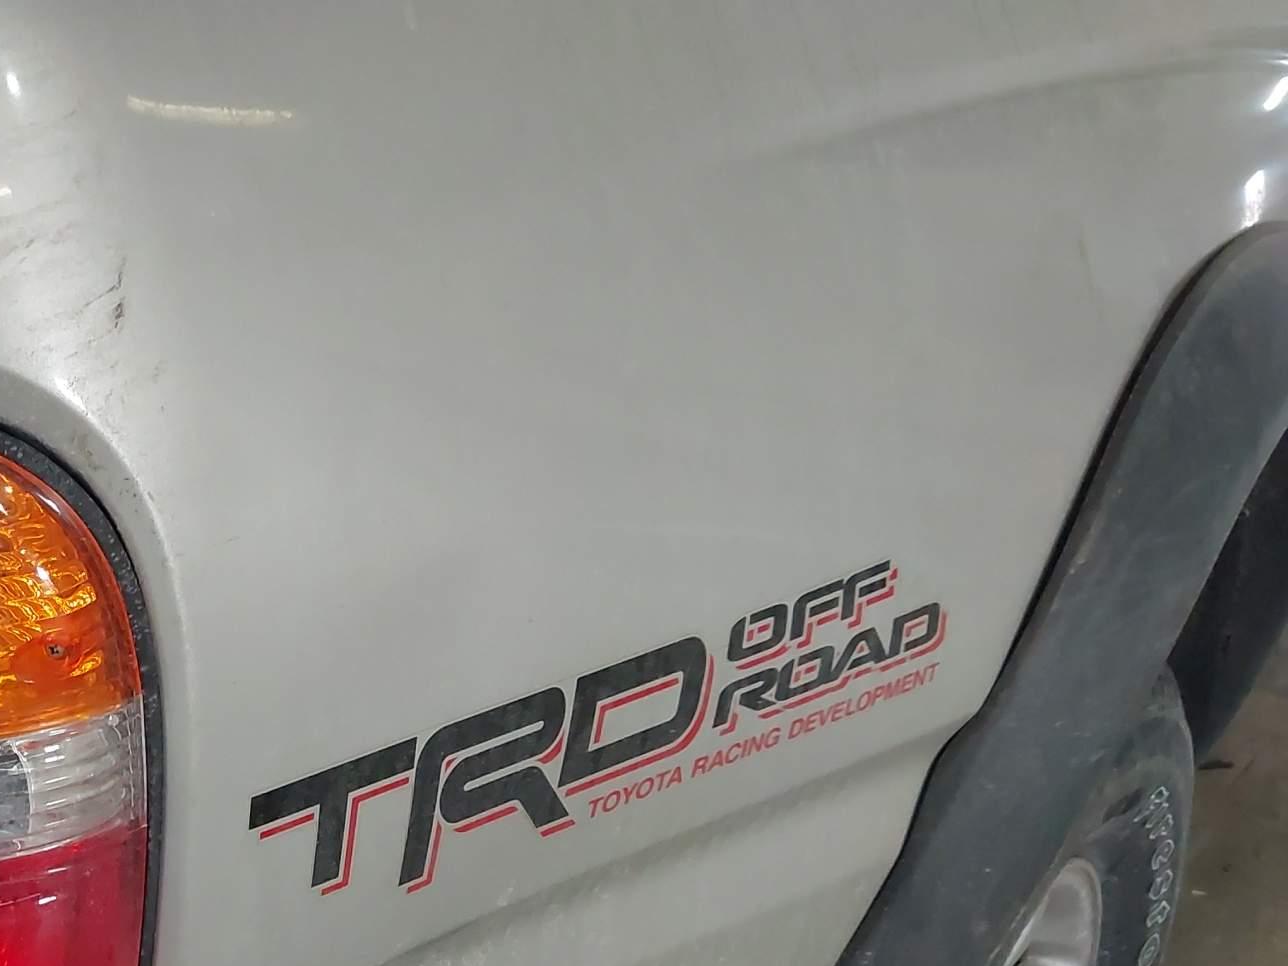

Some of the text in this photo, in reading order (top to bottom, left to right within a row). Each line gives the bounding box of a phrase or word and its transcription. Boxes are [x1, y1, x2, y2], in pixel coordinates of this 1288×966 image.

[712, 602, 948, 735] ROAD
[727, 559, 898, 669] OFF
[248, 635, 715, 896] TRD
[588, 661, 941, 819] TOYOTA RACING DEVELOPMENT
